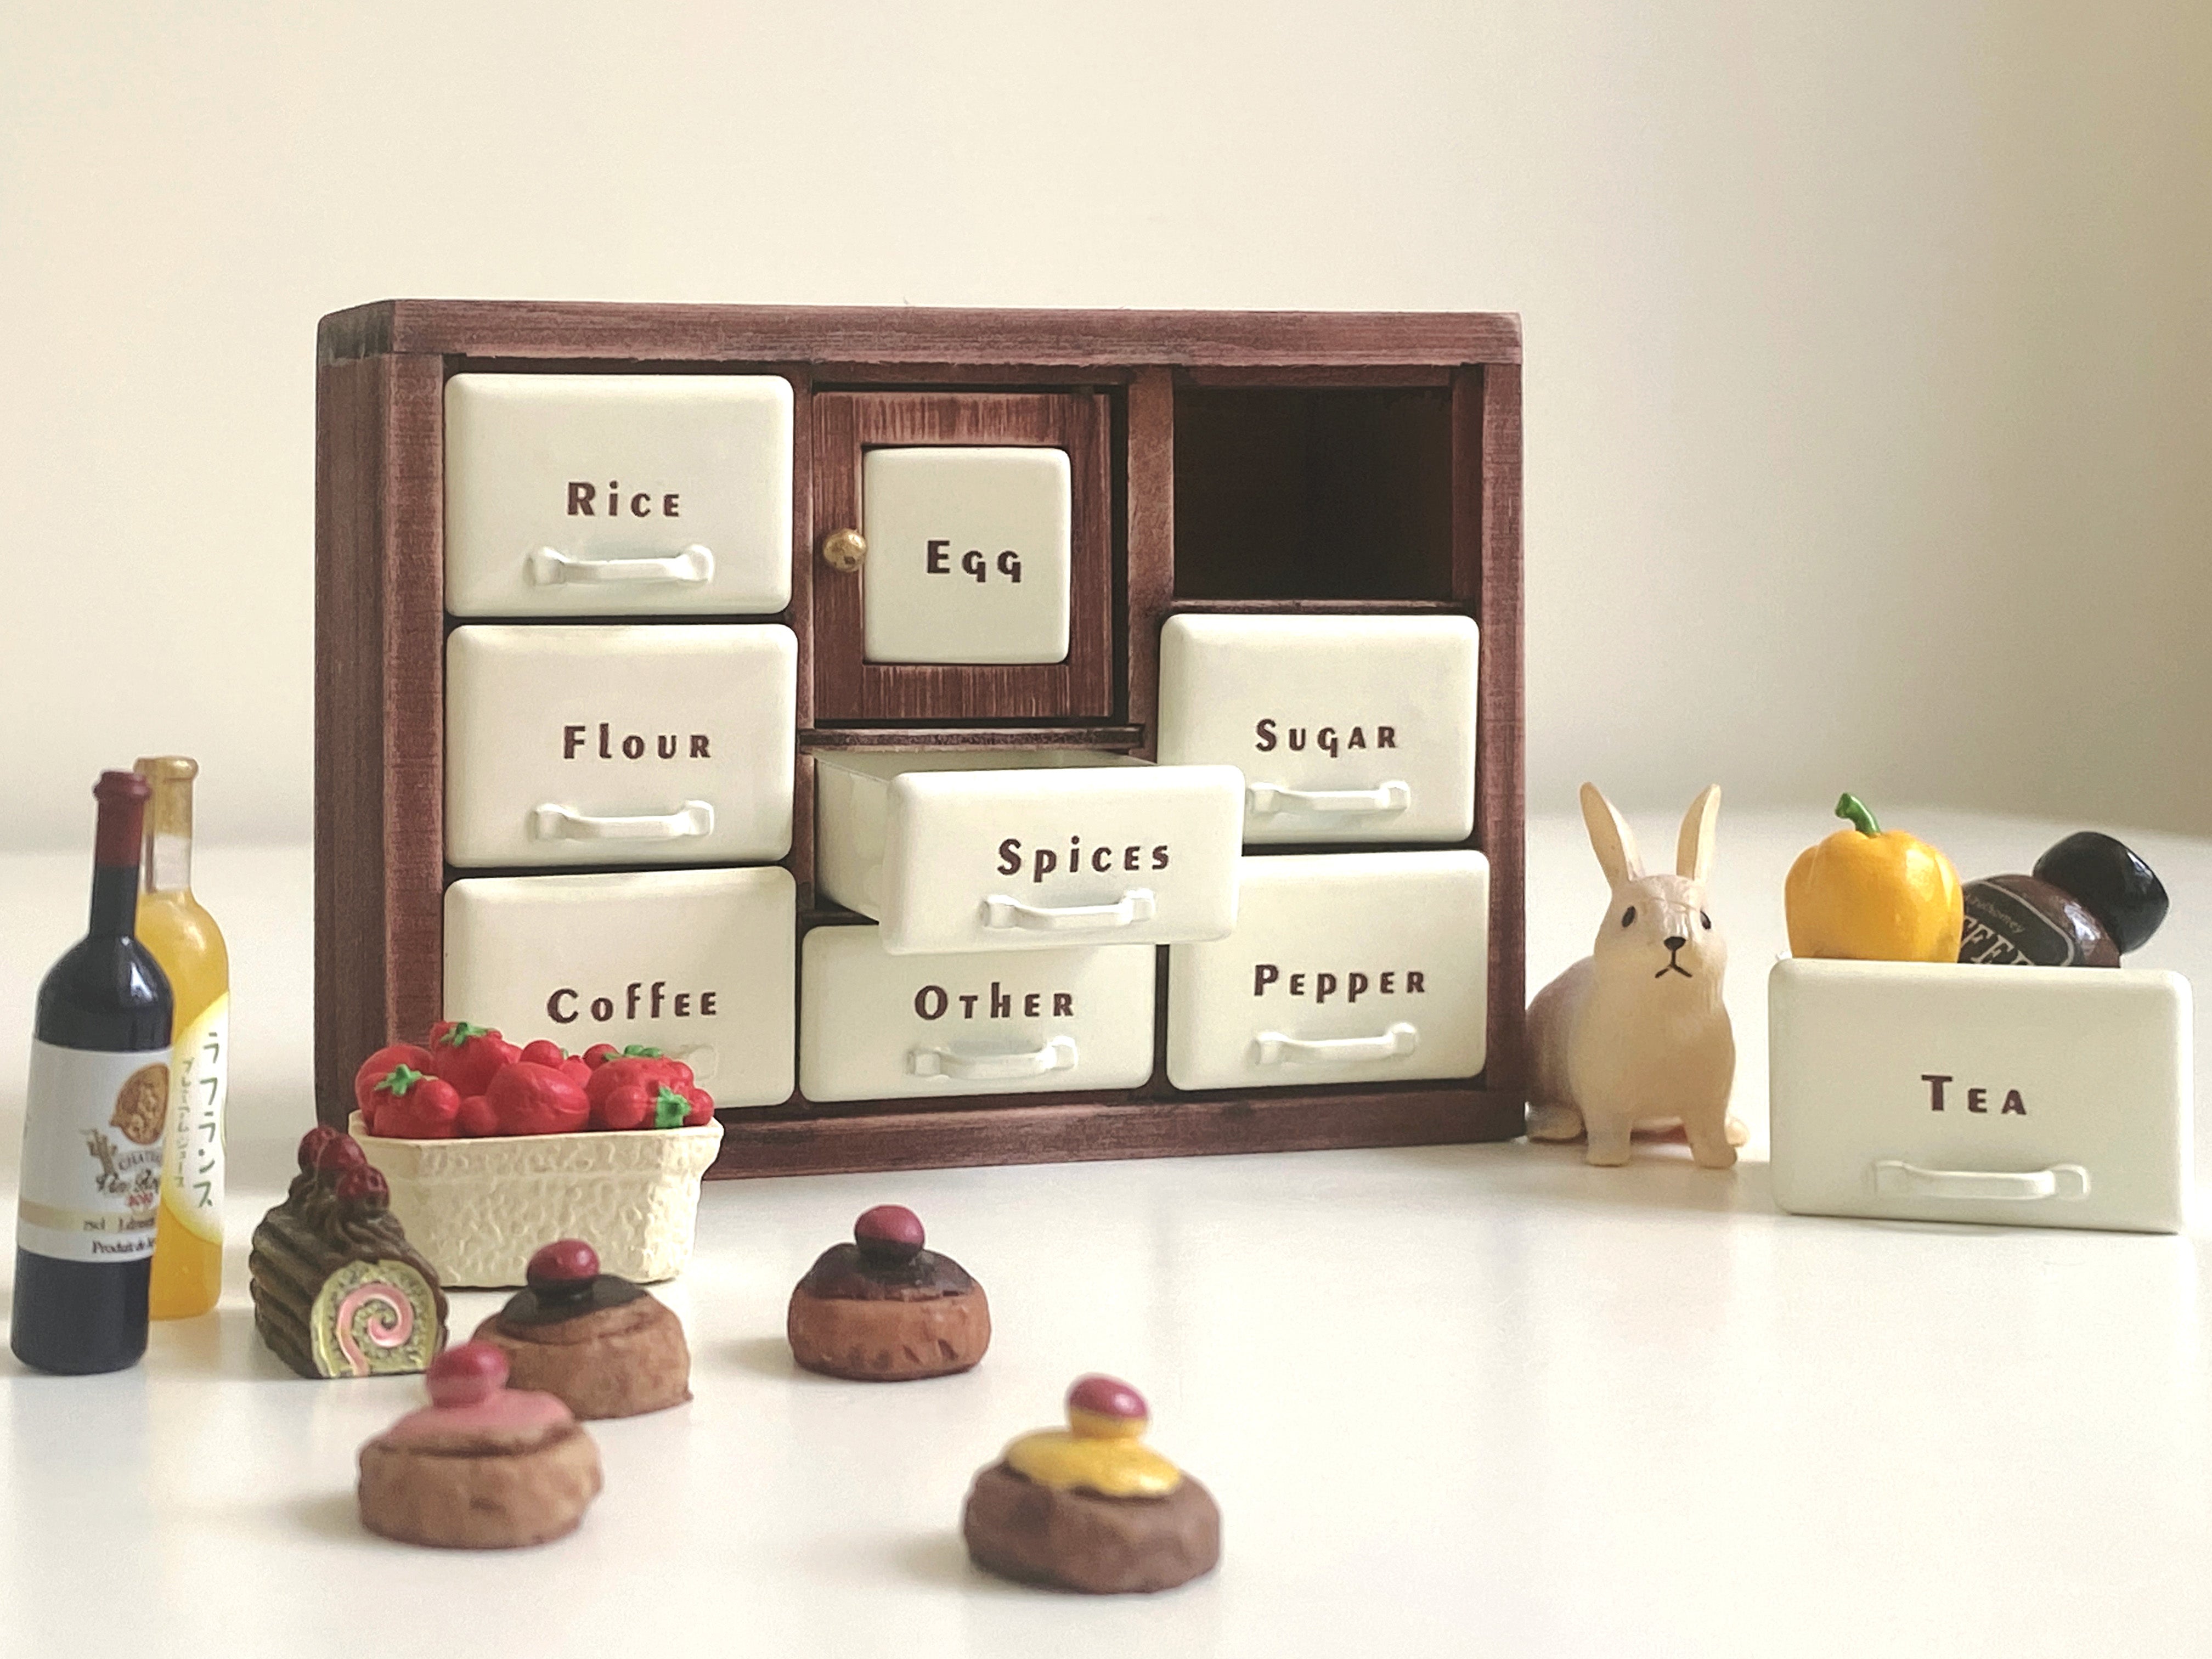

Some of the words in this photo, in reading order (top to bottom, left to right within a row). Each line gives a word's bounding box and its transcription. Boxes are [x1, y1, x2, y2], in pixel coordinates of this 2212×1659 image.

[567, 480, 680, 518] Rice
[926, 539, 1022, 584] Egg
[563, 722, 712, 761] Flour
[1255, 718, 1397, 759] Sugar
[996, 835, 1170, 883] Spices
[546, 981, 718, 1024] Coffee
[914, 981, 1075, 1021] Other
[1254, 964, 1429, 1005] Pepper
[1920, 1074, 2028, 1116] Tea
[193, 1031, 219, 1208] ラフランス
